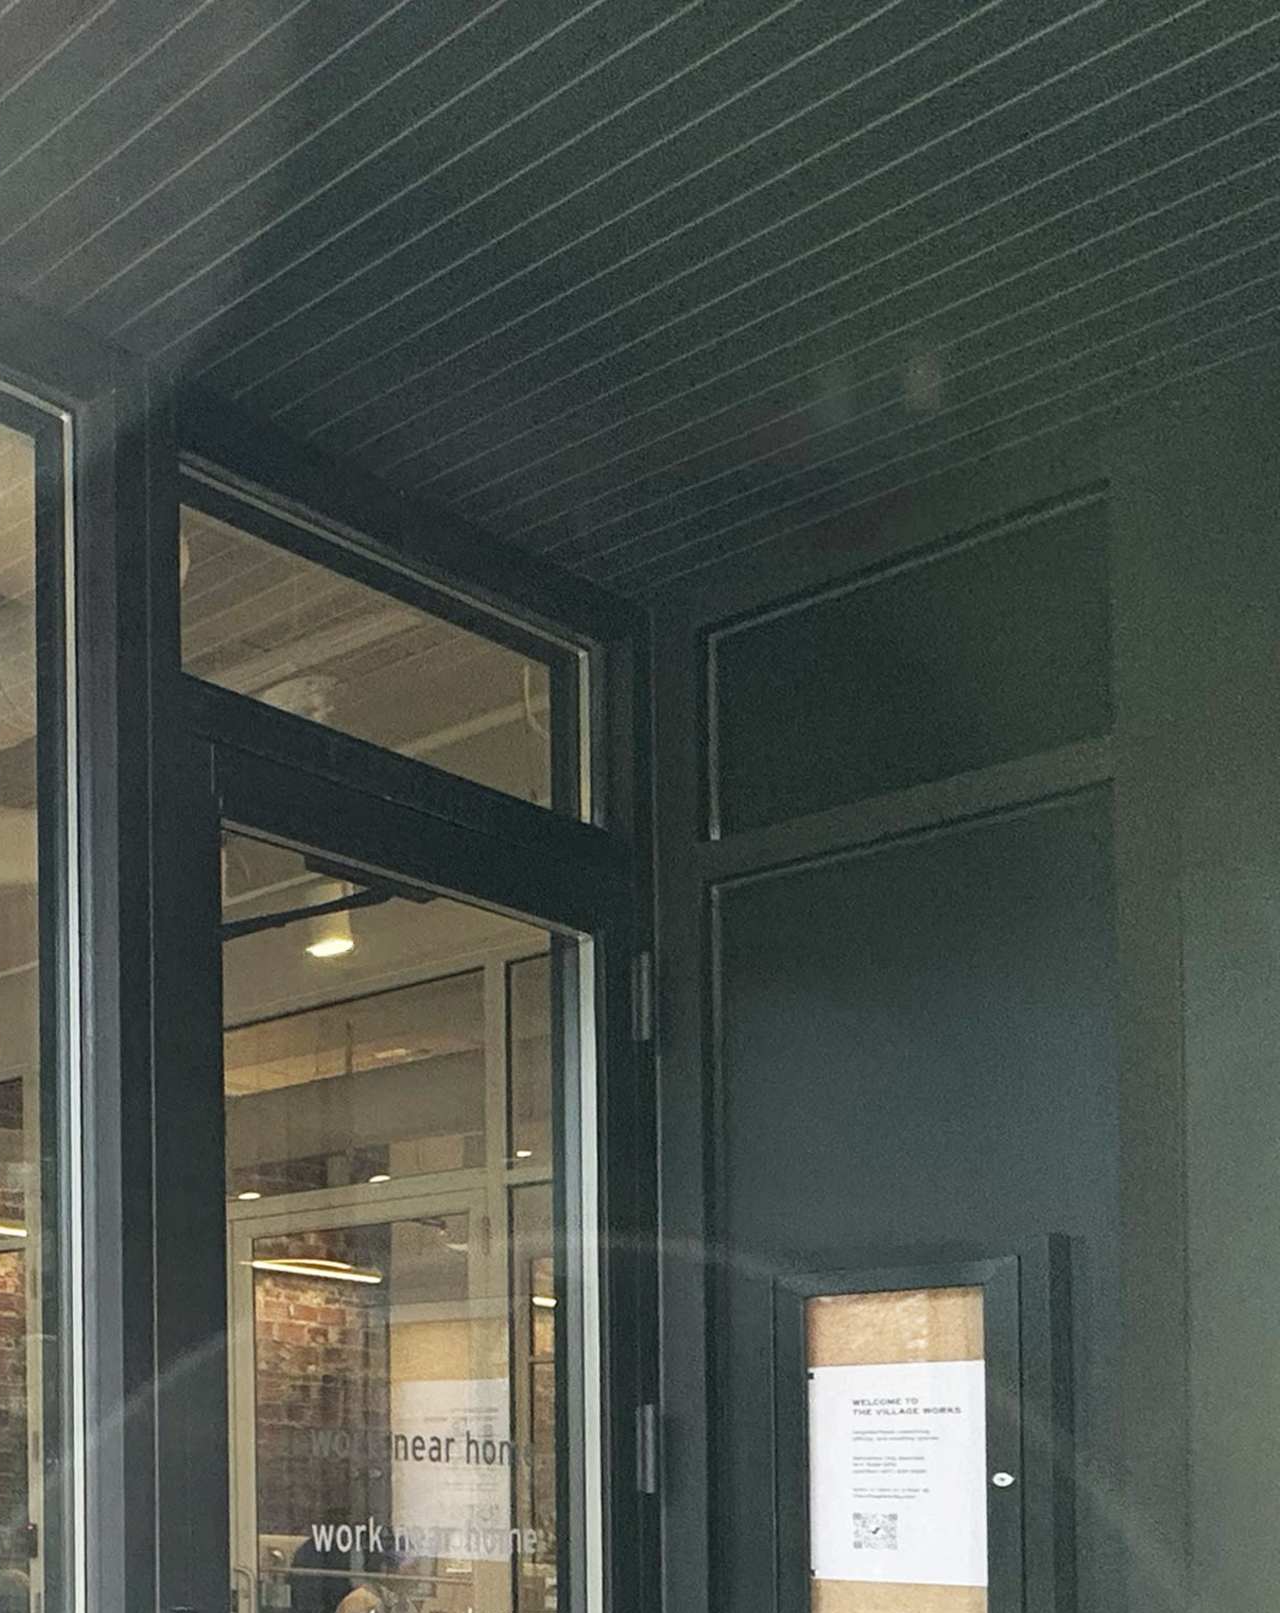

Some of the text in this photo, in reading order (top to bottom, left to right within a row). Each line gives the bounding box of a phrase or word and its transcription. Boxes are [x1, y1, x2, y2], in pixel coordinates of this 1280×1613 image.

[852, 1398, 901, 1406] WELCOME
[852, 1406, 962, 1416] THE VILLAGE WORKS
[394, 1433, 455, 1464] near
[312, 1517, 383, 1553] work
